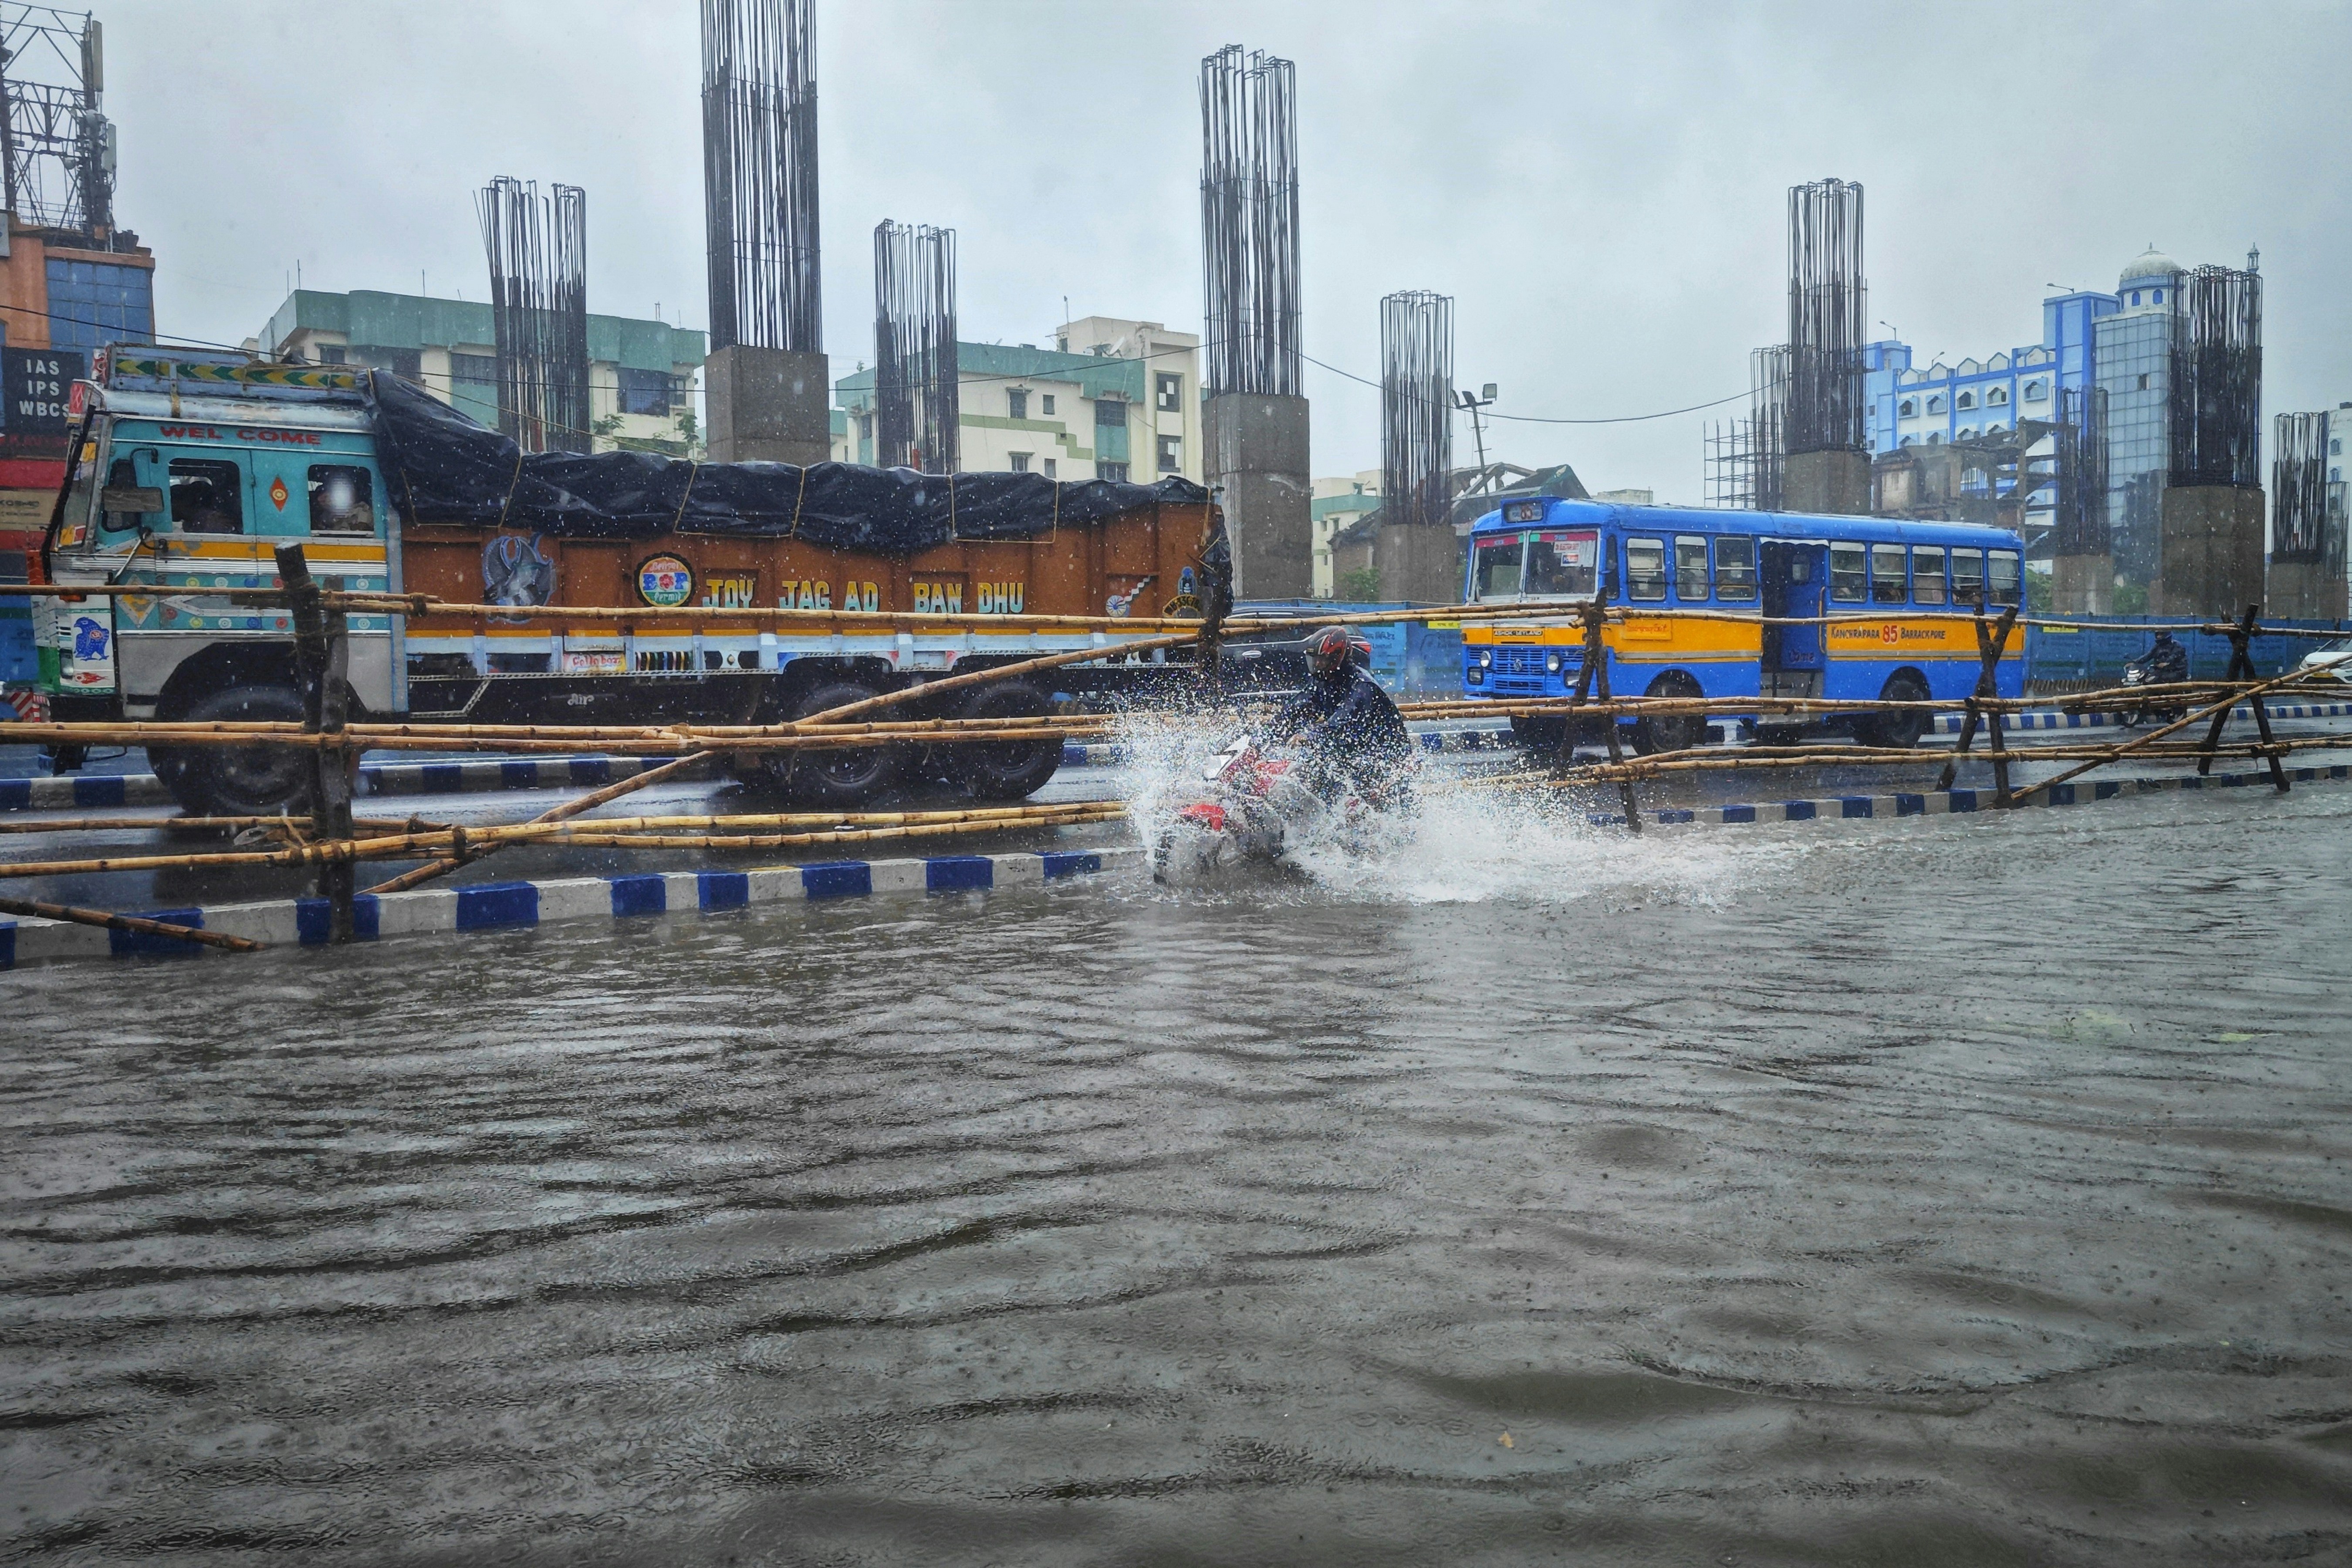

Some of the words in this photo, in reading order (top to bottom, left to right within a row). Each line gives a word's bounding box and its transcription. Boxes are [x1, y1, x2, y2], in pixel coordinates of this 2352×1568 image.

[27, 359, 59, 375] IAS
[27, 379, 59, 396] IPS
[19, 400, 69, 417] WBCS
[160, 426, 223, 439] WEL
[236, 429, 321, 445] COME
[702, 579, 754, 608] JOY
[779, 581, 830, 609] JAG
[844, 581, 878, 612] AD
[914, 582, 962, 613] BAN
[977, 582, 1024, 614] DHU
[1882, 625, 1898, 643] 85
[567, 693, 595, 706] Air
